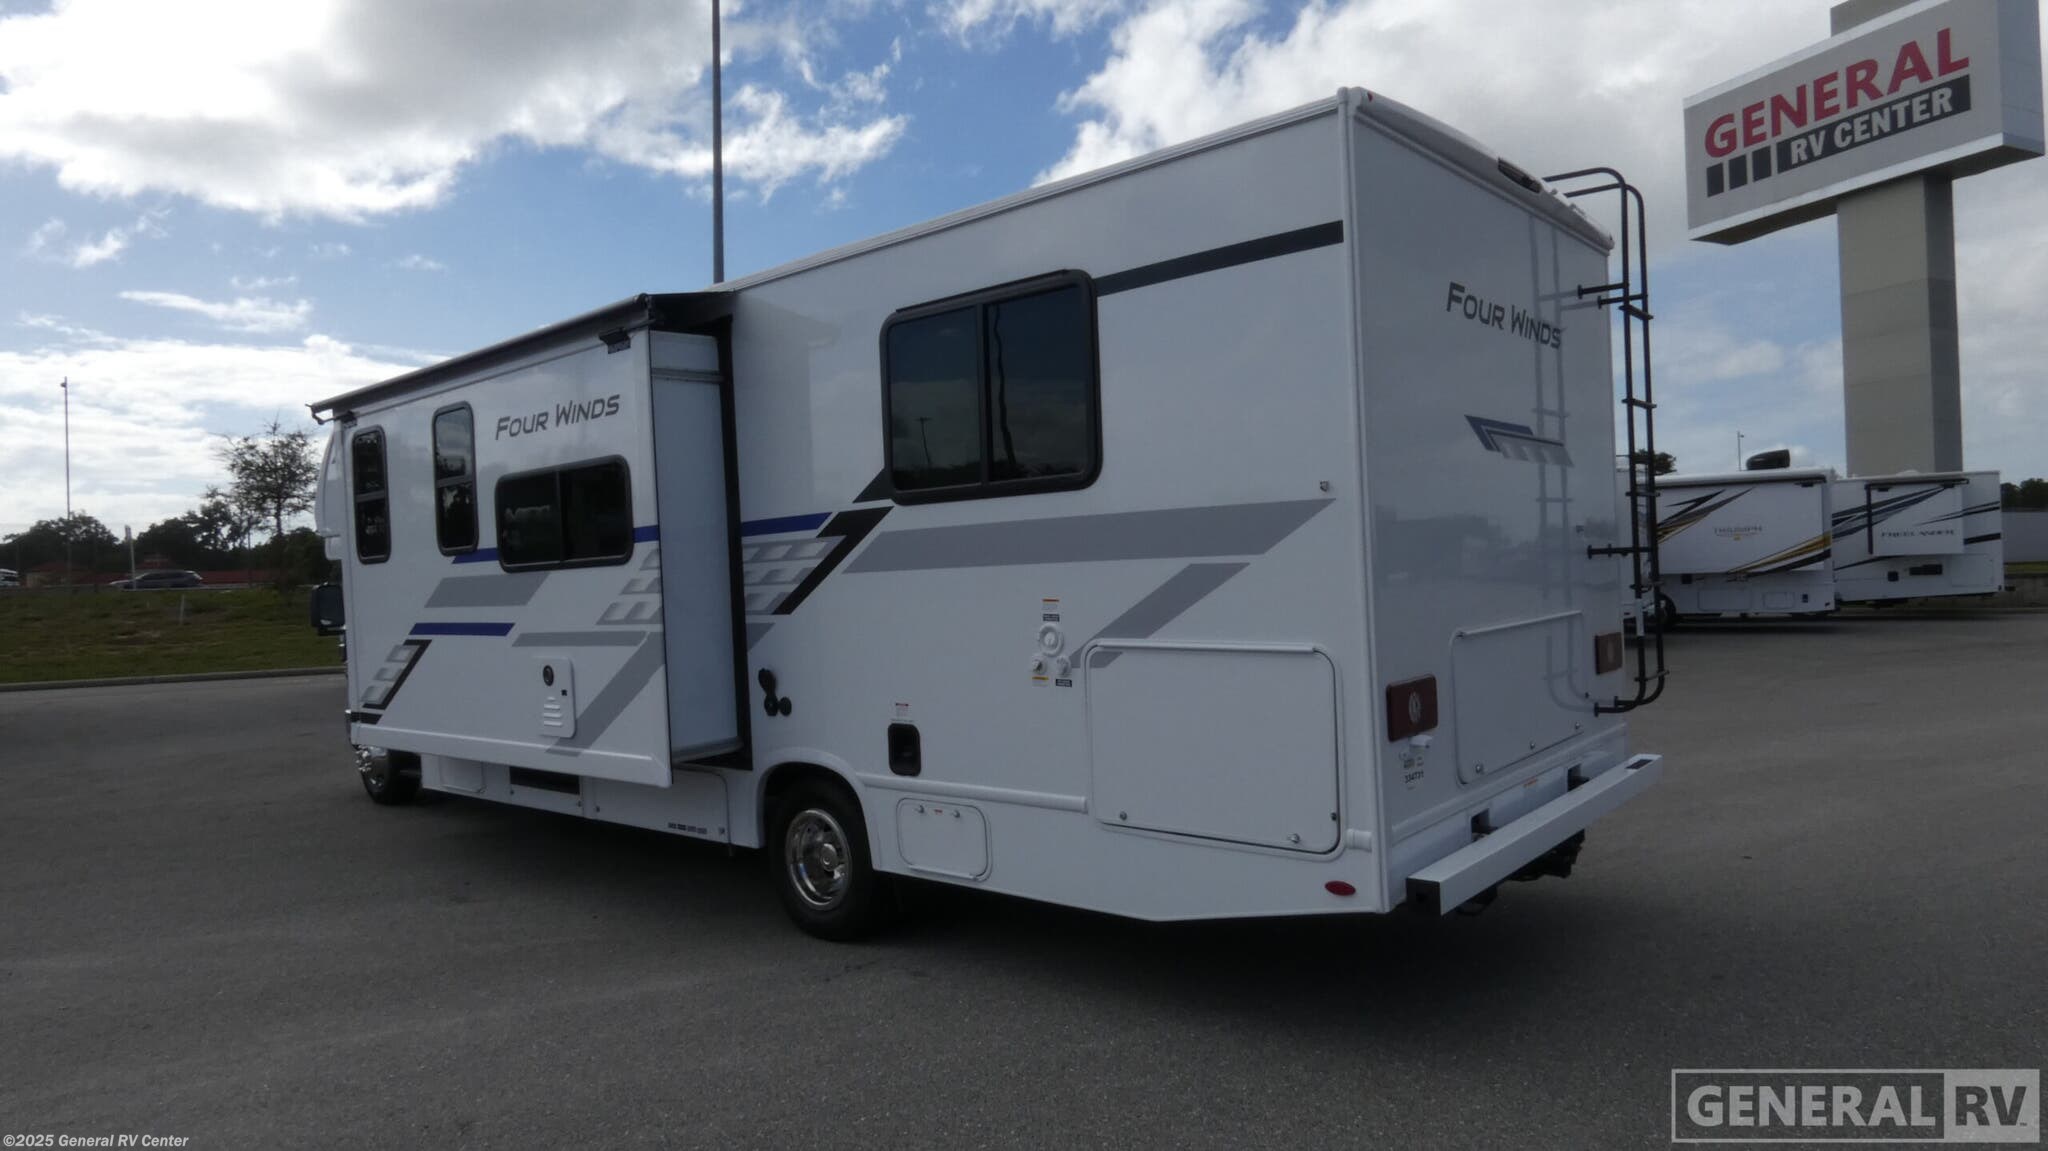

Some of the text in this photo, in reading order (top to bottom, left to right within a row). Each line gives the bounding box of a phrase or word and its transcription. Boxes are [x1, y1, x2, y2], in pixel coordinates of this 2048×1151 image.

[1705, 28, 1969, 158] GENERAL
[1790, 87, 1953, 165] RV CENTER
[1446, 281, 1561, 349] FOUR WINDS
[495, 394, 620, 440] FOUR WINDS
